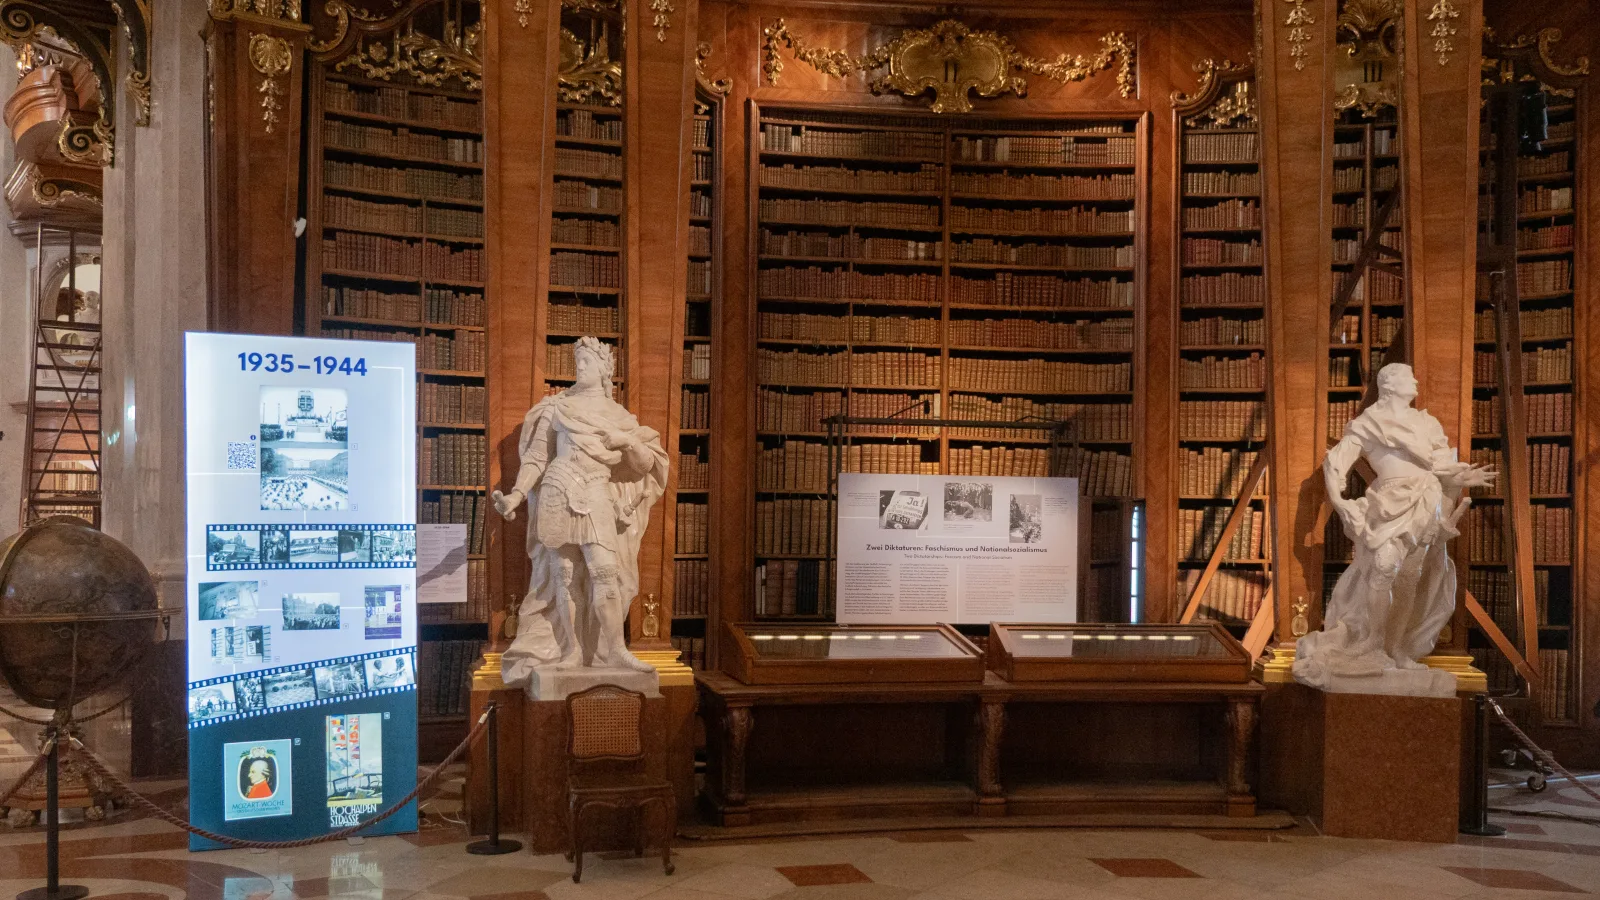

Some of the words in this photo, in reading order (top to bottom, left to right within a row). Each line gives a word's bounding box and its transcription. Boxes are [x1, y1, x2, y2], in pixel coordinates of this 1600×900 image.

[238, 352, 367, 376] 1935–1944
[231, 802, 259, 810] MOZART
[261, 800, 285, 808] WOCHE
[330, 803, 377, 816] HOCHALPEN
[330, 813, 360, 825] STRASSE
